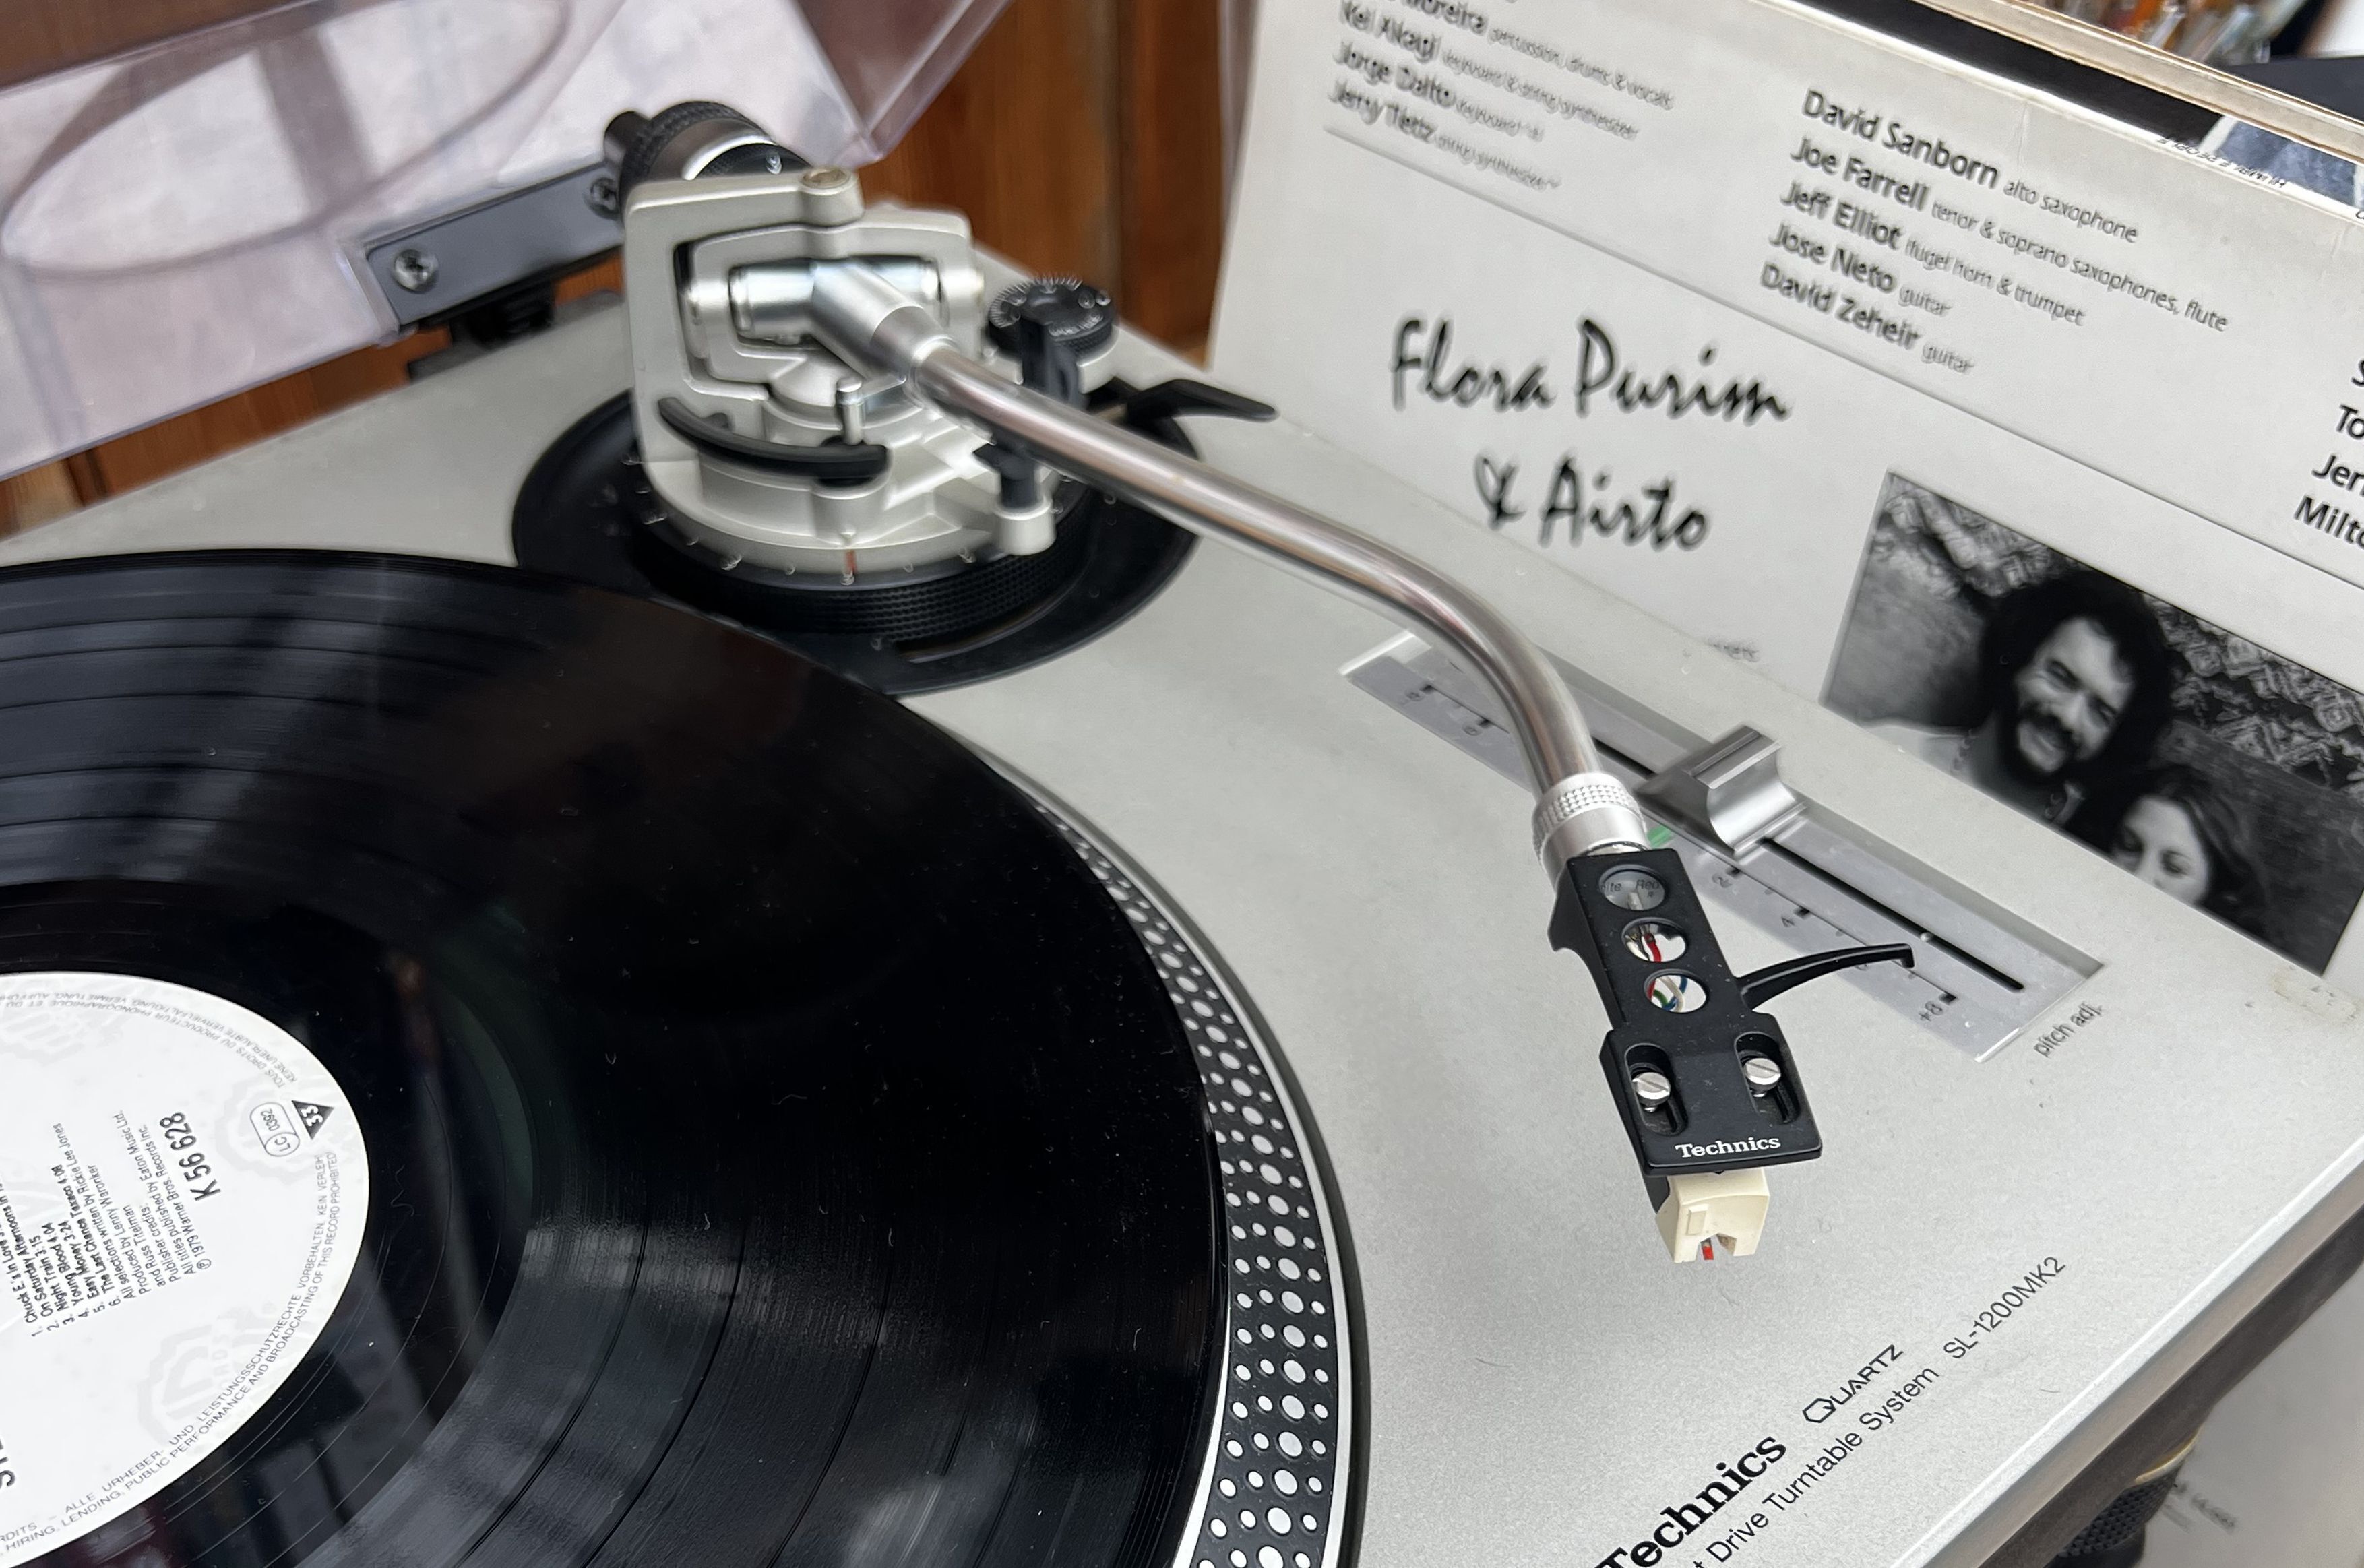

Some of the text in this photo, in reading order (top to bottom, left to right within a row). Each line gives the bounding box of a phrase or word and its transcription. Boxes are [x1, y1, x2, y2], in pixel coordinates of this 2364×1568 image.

[1802, 89, 2139, 243] David Sanborn alto saxophone
[1790, 135, 2227, 332] Joe Farrell tenor & soprano saxophones, flute
[1768, 220, 1952, 318] Jose Neto guitar
[1780, 181, 1832, 220] Jeff
[1832, 201, 1904, 251] Elliot
[1996, 273, 2012, 296] &
[2014, 283, 2086, 327] trumpet
[1760, 260, 1837, 315] David
[1921, 341, 1974, 375] guitar
[1390, 319, 1789, 425] Flora Purim
[2311, 453, 2364, 497] Jer
[1474, 456, 1709, 551] & Airto
[2034, 1001, 2102, 1058] pitch adj.
[260, 1108, 291, 1152] LC 0392
[301, 1106, 323, 1127] 33
[121, 1127, 140, 1155] Music
[144, 1140, 168, 1178] Records
[159, 1112, 221, 1202] K 56 628
[1675, 1137, 1781, 1158] Technics
[134, 1154, 153, 1182] Eaton
[146, 1181, 158, 1194] by
[52, 1123, 137, 1299] All selections written by Rickie Lee Jones
[148, 1193, 184, 1238] published
[173, 1201, 195, 1236] Warner
[325, 1205, 340, 1245] RECORD
[76, 1218, 98, 1253] Chance
[87, 1164, 152, 1295] Produced by Lenny Waronker
[122, 1204, 167, 1288] and Russ Titelman
[186, 1234, 206, 1258] 1979
[49, 1243, 71, 1274] Blood
[69, 1242, 90, 1276] Money
[90, 1251, 107, 1275] Last
[154, 1238, 182, 1282] Publisher
[172, 1237, 190, 1262] titles
[317, 1245, 332, 1265] THIS
[5, 1262, 19, 1275] In
[22, 1257, 53, 1302] Saturday
[39, 1256, 57, 1284] Train
[100, 1273, 115, 1294] The
[180, 1261, 197, 1275] All
[312, 1267, 323, 1285] OF
[49, 1282, 69, 1312] Night
[64, 1272, 84, 1307] Young
[83, 1275, 105, 1300] Easy
[16, 1291, 38, 1323] Chuck
[40, 1301, 54, 1317] On
[266, 1284, 318, 1368] BROADCASTING
[65, 1492, 96, 1514] ALLE
[168, 1424, 194, 1447] UND
[317, 1195, 329, 1216] KEIN
[249, 1361, 270, 1387] AND
[1802, 1344, 1904, 1423] QUARTZ
[169, 1383, 252, 1460] PERFORMANCE
[1706, 1257, 2066, 1563] Drive Turntable System SL-1200MK2
[126, 1457, 170, 1491] PUBLIC
[1594, 1436, 1786, 1568] Technics
